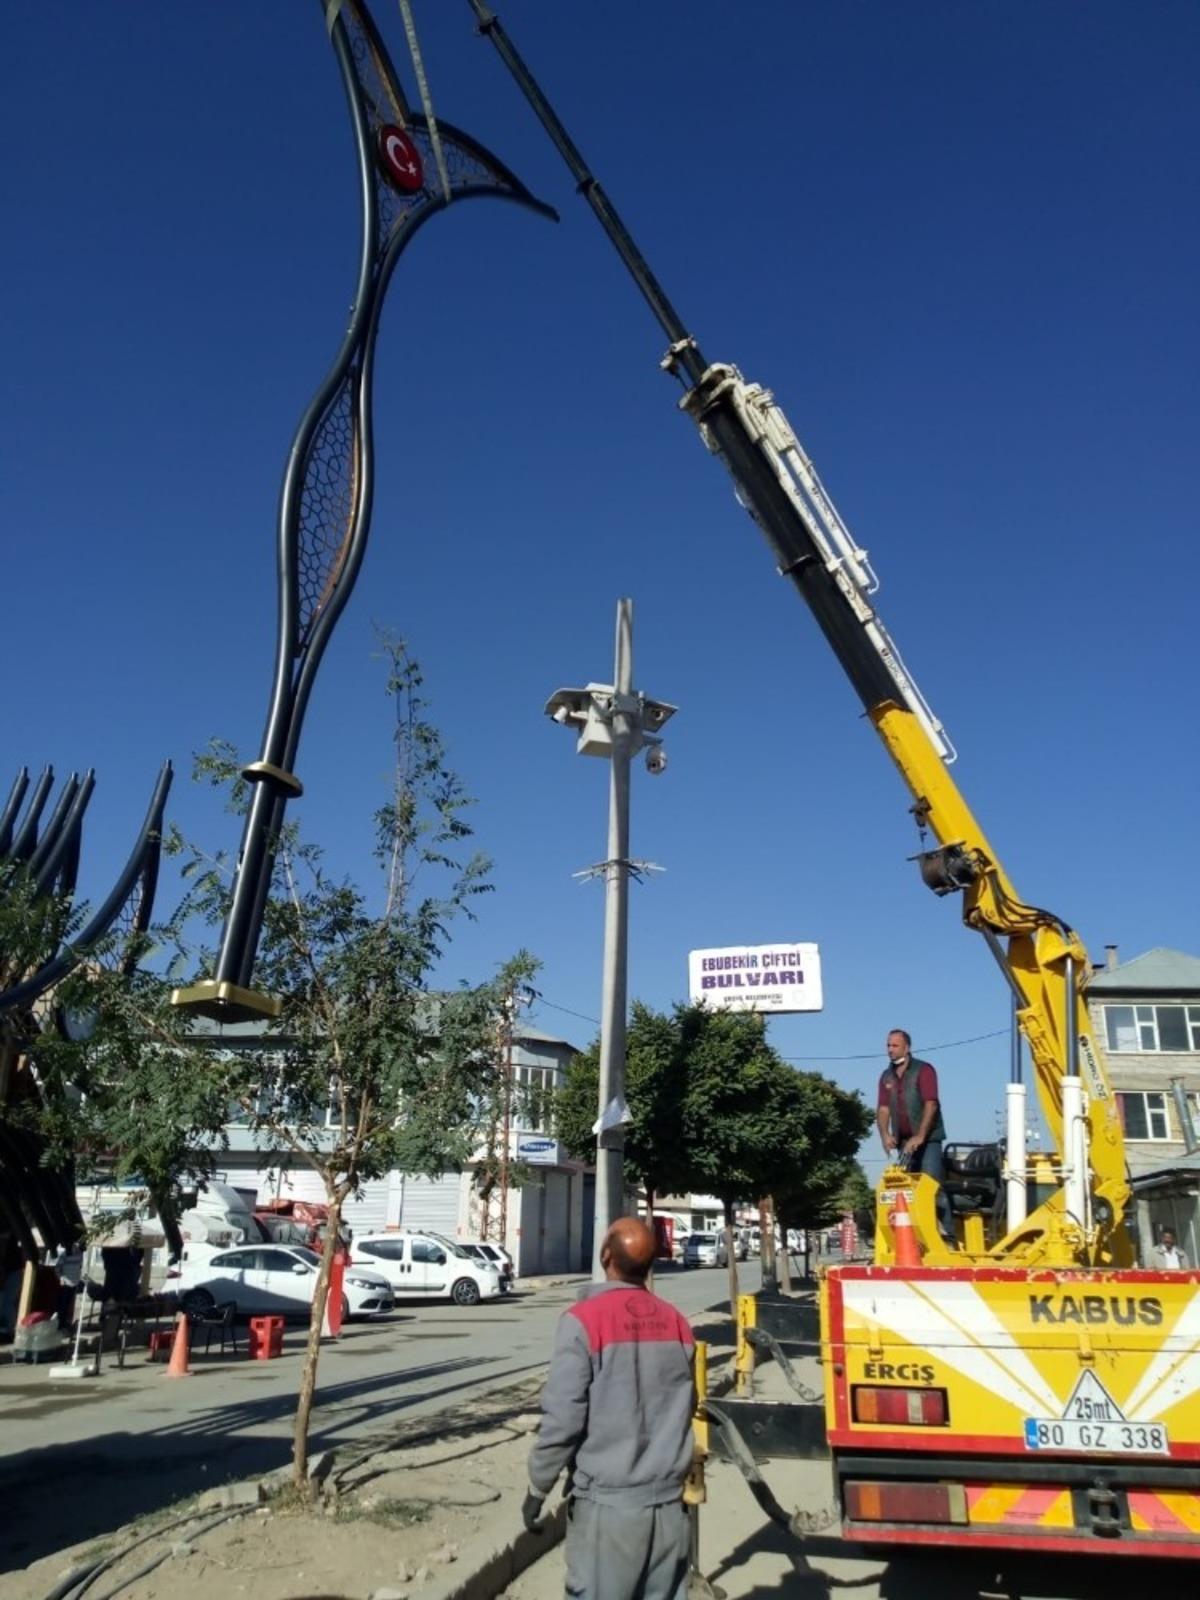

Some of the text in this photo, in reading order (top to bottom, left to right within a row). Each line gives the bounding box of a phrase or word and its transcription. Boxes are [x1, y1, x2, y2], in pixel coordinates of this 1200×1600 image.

[702, 953, 758, 971] EBUBEKİR
[701, 971, 804, 989] BULVARI
[1029, 1295, 1163, 1326] KABUS
[1075, 1397, 1112, 1420] 25mt
[1038, 1424, 1163, 1449] 80 GZ 338
